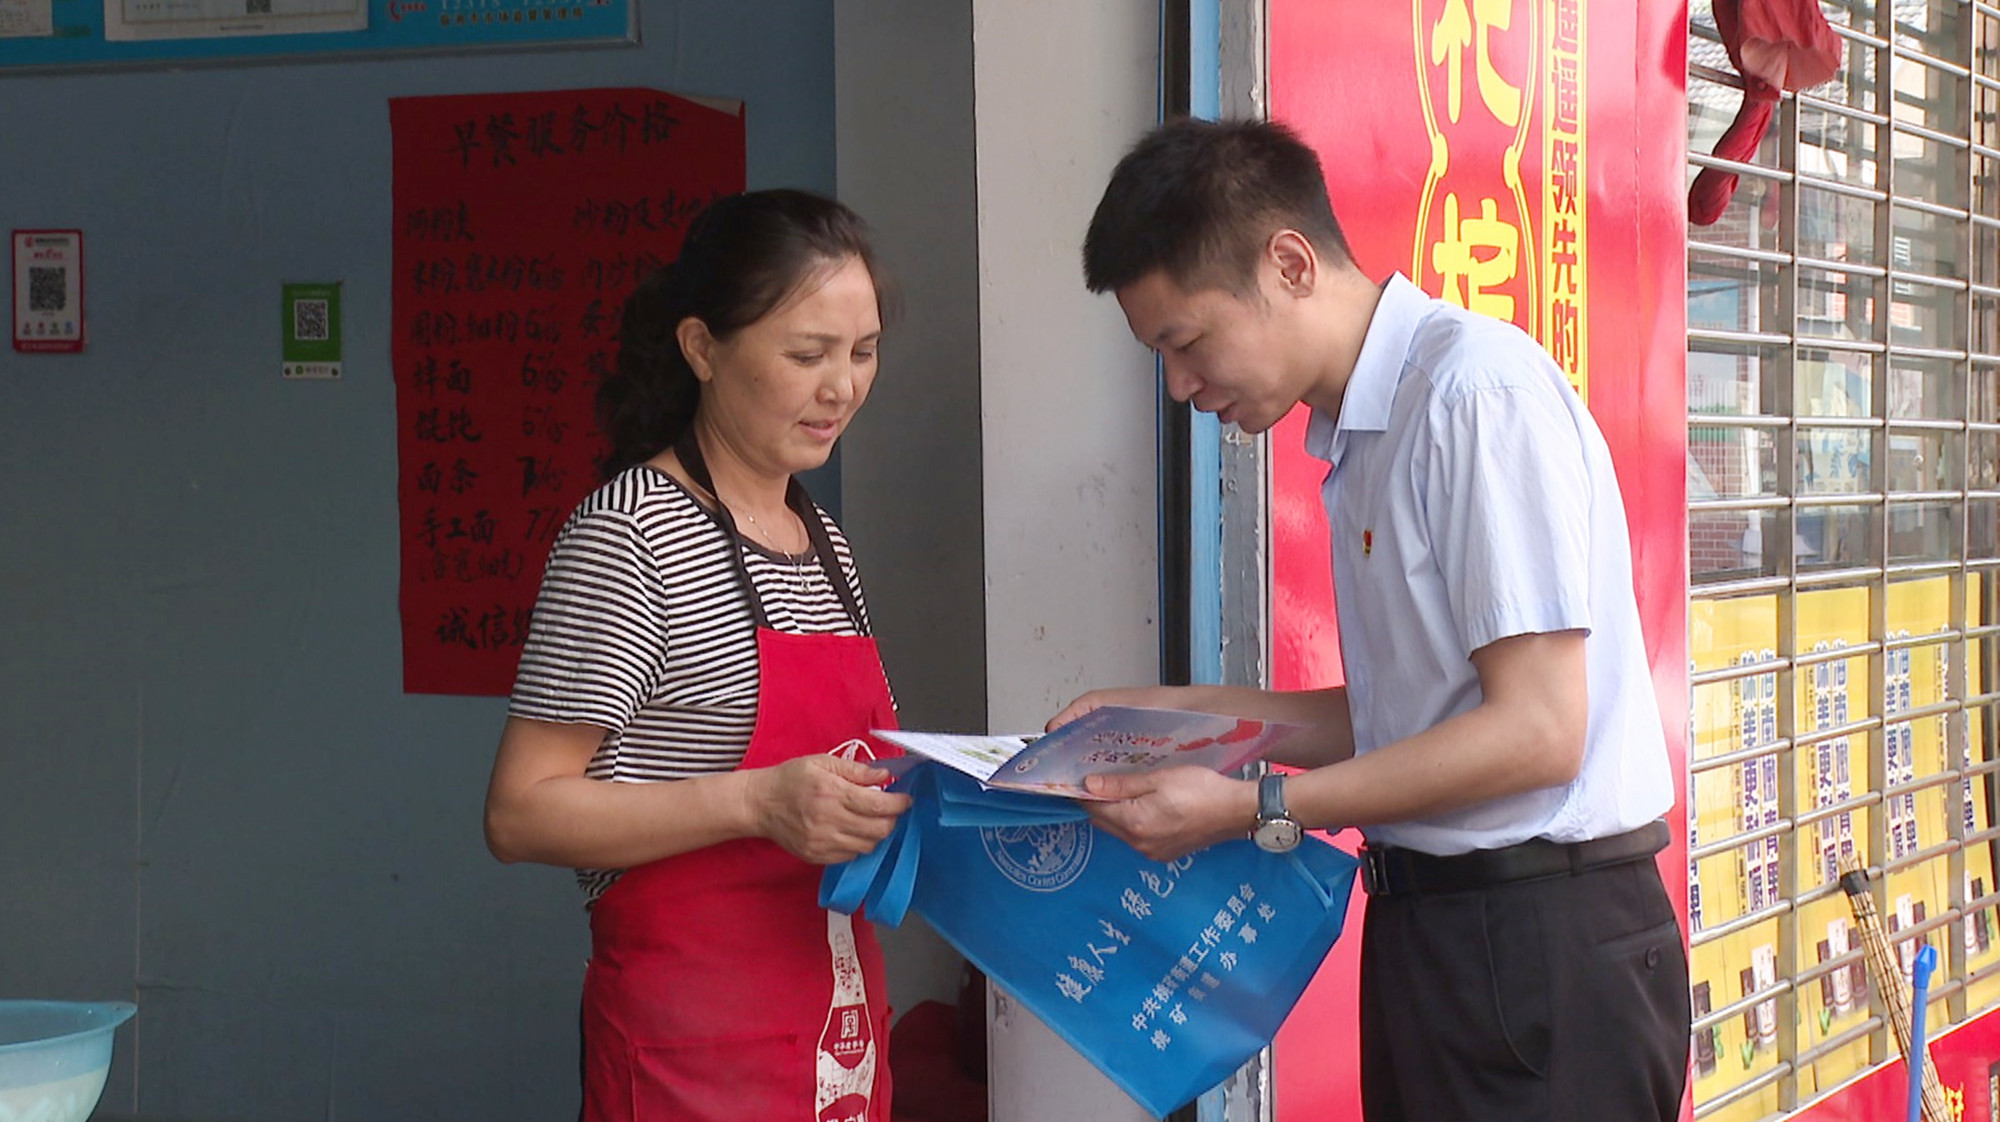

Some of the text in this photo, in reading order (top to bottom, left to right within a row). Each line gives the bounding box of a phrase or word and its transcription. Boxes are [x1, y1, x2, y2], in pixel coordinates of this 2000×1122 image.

[450, 100, 680, 169] 早餐服务价格
[1551, 0, 1579, 394] 遥遥领先的
[414, 508, 500, 548] 手工面
[1055, 919, 1132, 1004] 健康人生
